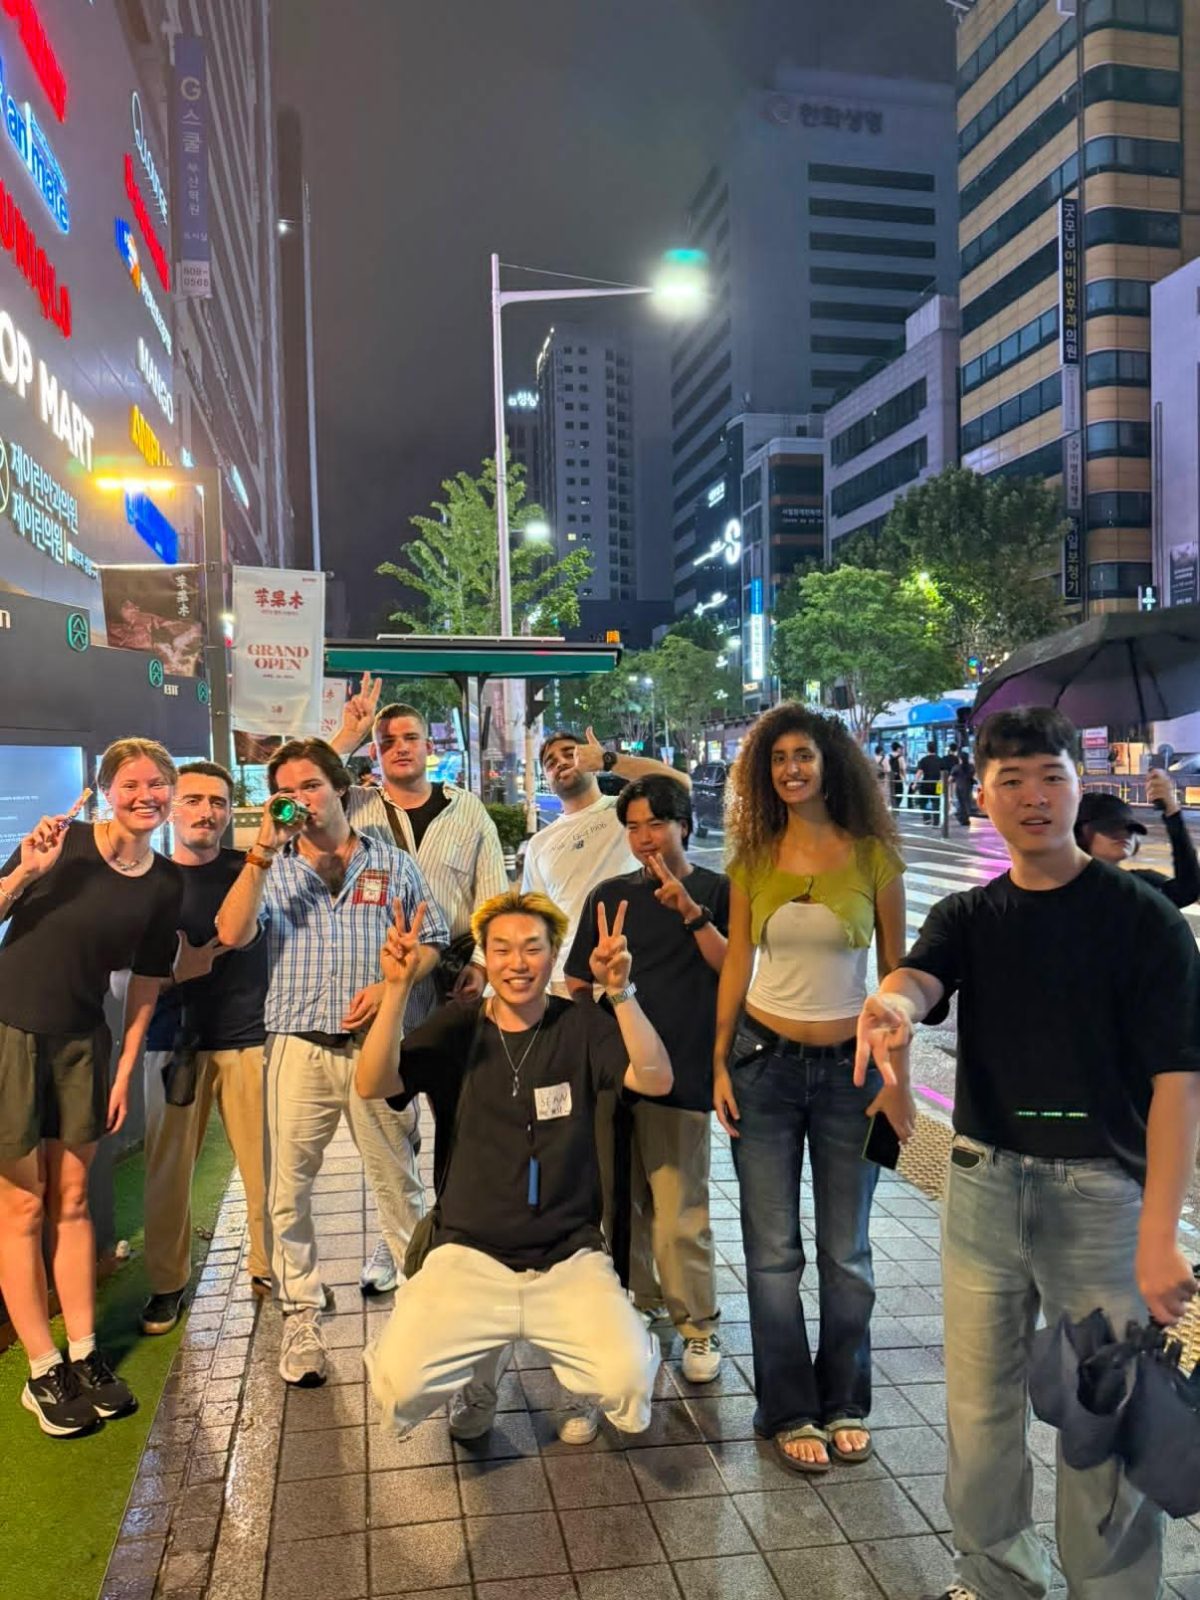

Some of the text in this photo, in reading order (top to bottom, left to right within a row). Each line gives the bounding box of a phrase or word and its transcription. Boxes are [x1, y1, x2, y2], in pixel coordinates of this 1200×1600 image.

[39, 359, 94, 473] MART
[247, 643, 309, 658] GRAND
[254, 657, 302, 670] OPEN
